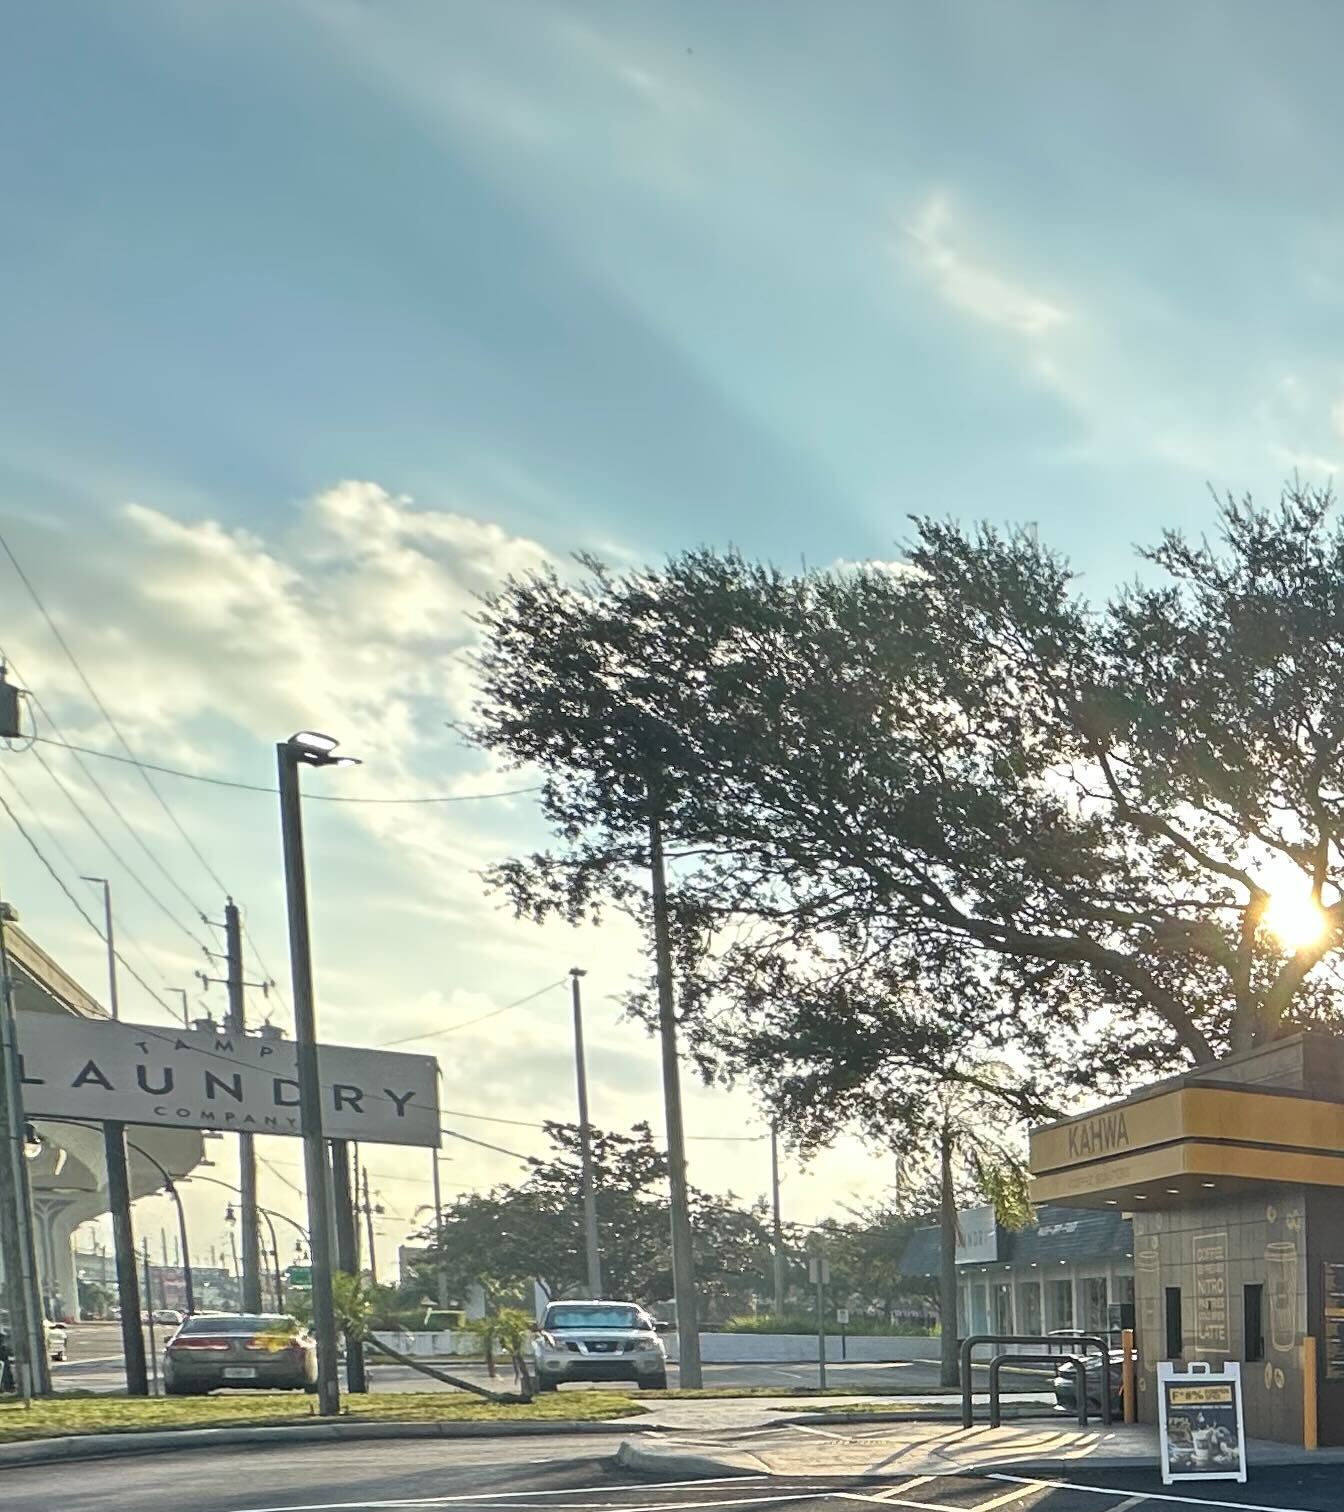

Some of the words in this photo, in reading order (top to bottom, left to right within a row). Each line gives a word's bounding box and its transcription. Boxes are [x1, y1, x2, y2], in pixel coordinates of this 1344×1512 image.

[135, 1038, 299, 1067] TAMP
[19, 1054, 416, 1117] LAUNDRY
[154, 1106, 297, 1127] COMPANY
[1068, 1112, 1130, 1158] KAHWA
[1199, 1278, 1224, 1294] NITRO
[1200, 1324, 1225, 1340] LATTE
